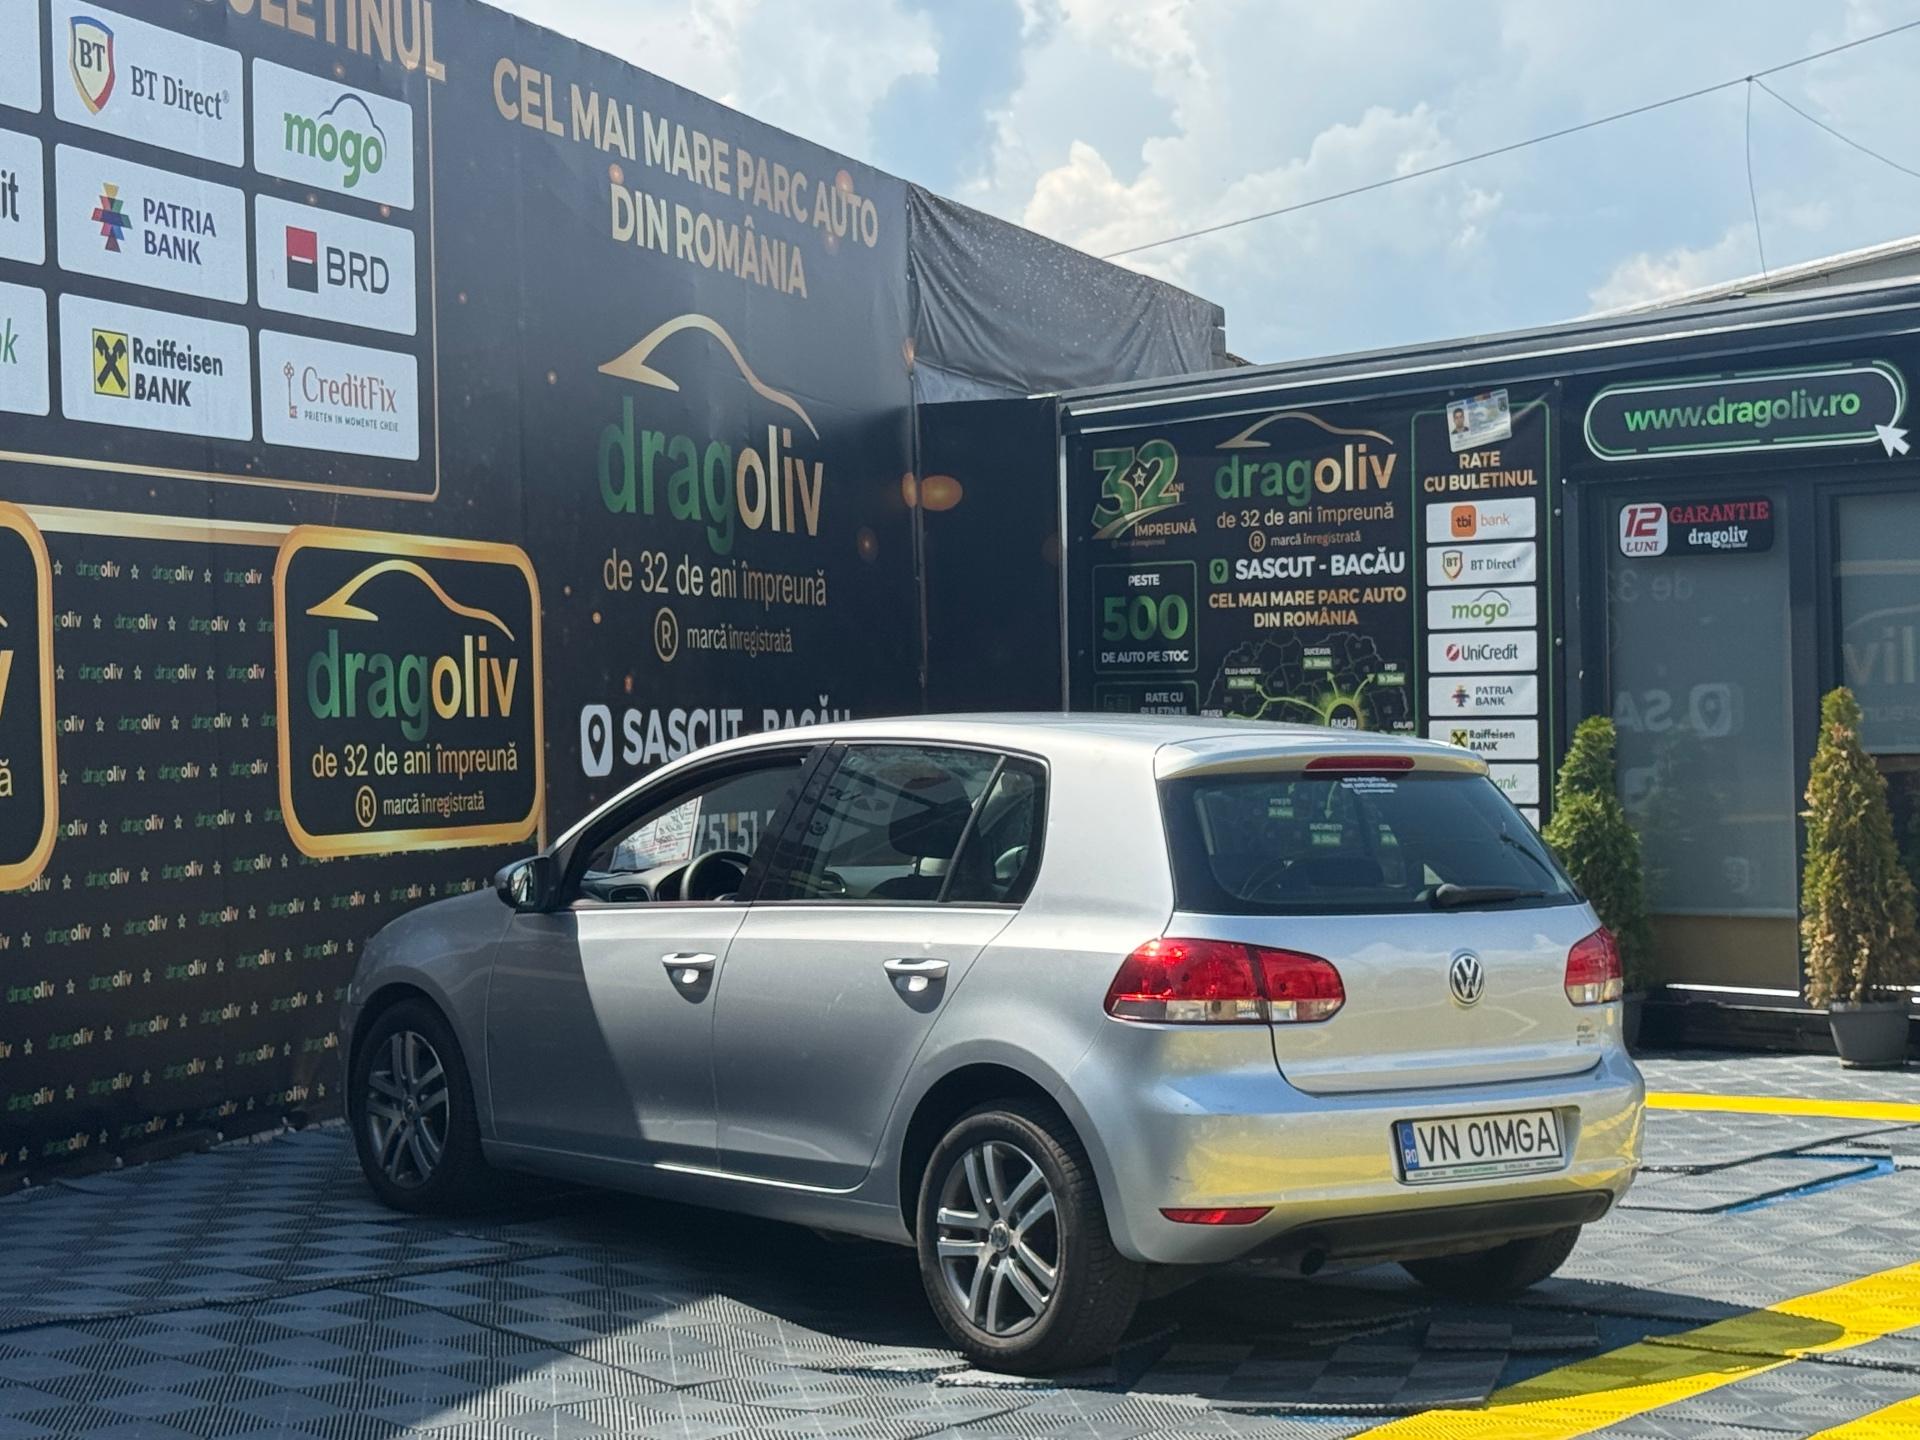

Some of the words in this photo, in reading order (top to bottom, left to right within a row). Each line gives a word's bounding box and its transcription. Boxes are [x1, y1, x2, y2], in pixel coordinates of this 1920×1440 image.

[78, 38, 106, 72] BT
[130, 65, 160, 100] BT
[284, 111, 383, 188] mogo
[493, 57, 565, 138] CEL
[571, 84, 637, 161] MAI
[643, 110, 731, 196] MARE
[737, 149, 808, 224] PARC
[813, 180, 879, 248] AUTO
[143, 197, 217, 238] PATRIA
[144, 229, 202, 266] BANK
[611, 184, 669, 254] DIN
[677, 204, 808, 299] ROMÂNIA
[326, 247, 390, 294] BRD
[133, 337, 223, 377] Raiffeisen
[135, 374, 191, 406] BANK
[302, 366, 397, 413] CreditFix
[1624, 389, 1861, 431] www.dragoliv.ro
[598, 396, 824, 555] dragoliv
[1215, 443, 1396, 507] dragoliv
[1459, 451, 1501, 470] RATE
[1424, 475, 1446, 492] CU
[1449, 470, 1538, 490] BULETINUL
[1216, 510, 1235, 529] de
[1240, 509, 1259, 527] 32
[1264, 508, 1284, 527] de
[1289, 506, 1312, 525] ani
[1317, 502, 1395, 526] împreună
[1456, 515, 1472, 528] tbi
[1481, 513, 1510, 526] bank
[1624, 506, 1663, 538] 12
[1669, 501, 1769, 524] GARANTIE
[1270, 532, 1301, 547] marcă
[1303, 530, 1361, 548] înregistrată
[1625, 541, 1659, 552] LUNI
[1688, 526, 1748, 548] dragoliv
[76, 560, 120, 583] dragoliv
[152, 562, 194, 584] dragoliv
[223, 565, 262, 586] dragoliv
[1235, 556, 1316, 580] SASCUT
[1330, 547, 1406, 576] BACĂU
[1470, 559, 1484, 571] BT
[603, 548, 633, 592] de
[640, 550, 669, 593] 32
[676, 554, 703, 597] de
[710, 560, 737, 599] ani
[742, 561, 827, 611] împreună
[1128, 574, 1160, 586] PESTE
[1209, 592, 1237, 609] CEL
[1240, 591, 1267, 608] MAI
[1270, 589, 1315, 607] MARE
[1318, 587, 1360, 605] PARC
[1362, 586, 1407, 603] AUTO
[114, 613, 158, 633] dragoliv
[188, 613, 229, 634] dragoliv
[1102, 594, 1189, 641] 500
[1254, 613, 1280, 629] DIN
[1283, 606, 1359, 627] ROMÂNIA
[1451, 601, 1509, 625] mogo
[687, 623, 727, 650] marcă
[728, 625, 793, 657] înregistrată
[1461, 643, 1518, 660] UniCredit
[1102, 652, 1116, 663] DE
[1117, 652, 1146, 663] AUTO
[1147, 651, 1161, 662] PE
[1162, 650, 1189, 662] STOC
[78, 663, 123, 684] dragoliv
[154, 663, 196, 684] dragoliv
[226, 663, 264, 684] dragoliv
[307, 629, 518, 741] dragoliv
[1475, 685, 1513, 696] PATRIA
[1475, 696, 1505, 706] BANK
[118, 713, 161, 735] dragoliv
[191, 712, 232, 733] dragoliv
[1469, 729, 1515, 740] Raiffeisen
[312, 745, 337, 778] de
[344, 743, 368, 778] 32
[374, 743, 398, 776] de
[403, 743, 430, 774] ani
[436, 742, 517, 780] împreună
[1470, 741, 1498, 751] BANK
[81, 765, 126, 786] dragoliv
[157, 761, 200, 784] dragoliv
[229, 758, 268, 779] dragoliv
[383, 793, 420, 815] marcă
[421, 790, 485, 818] înregistrată
[121, 814, 164, 836] dragoliv
[195, 807, 235, 830] dragoliv
[84, 867, 130, 890] dragoliv
[160, 860, 204, 882] dragoliv
[232, 853, 272, 876] dragoliv
[45, 923, 92, 946] dragoliv
[123, 914, 168, 936] dragoliv
[198, 905, 239, 928] dragoliv
[267, 897, 305, 918] dragoliv
[7, 980, 55, 1004] dragoliv
[88, 969, 133, 993] dragoliv
[166, 958, 207, 980] dragoliv
[48, 1027, 95, 1050] dragoliv
[126, 1015, 170, 1038] dragoliv
[1417, 1124, 1461, 1163] VN
[1468, 1117, 1556, 1157] 01MGA
[1404, 1148, 1418, 1164] RO
